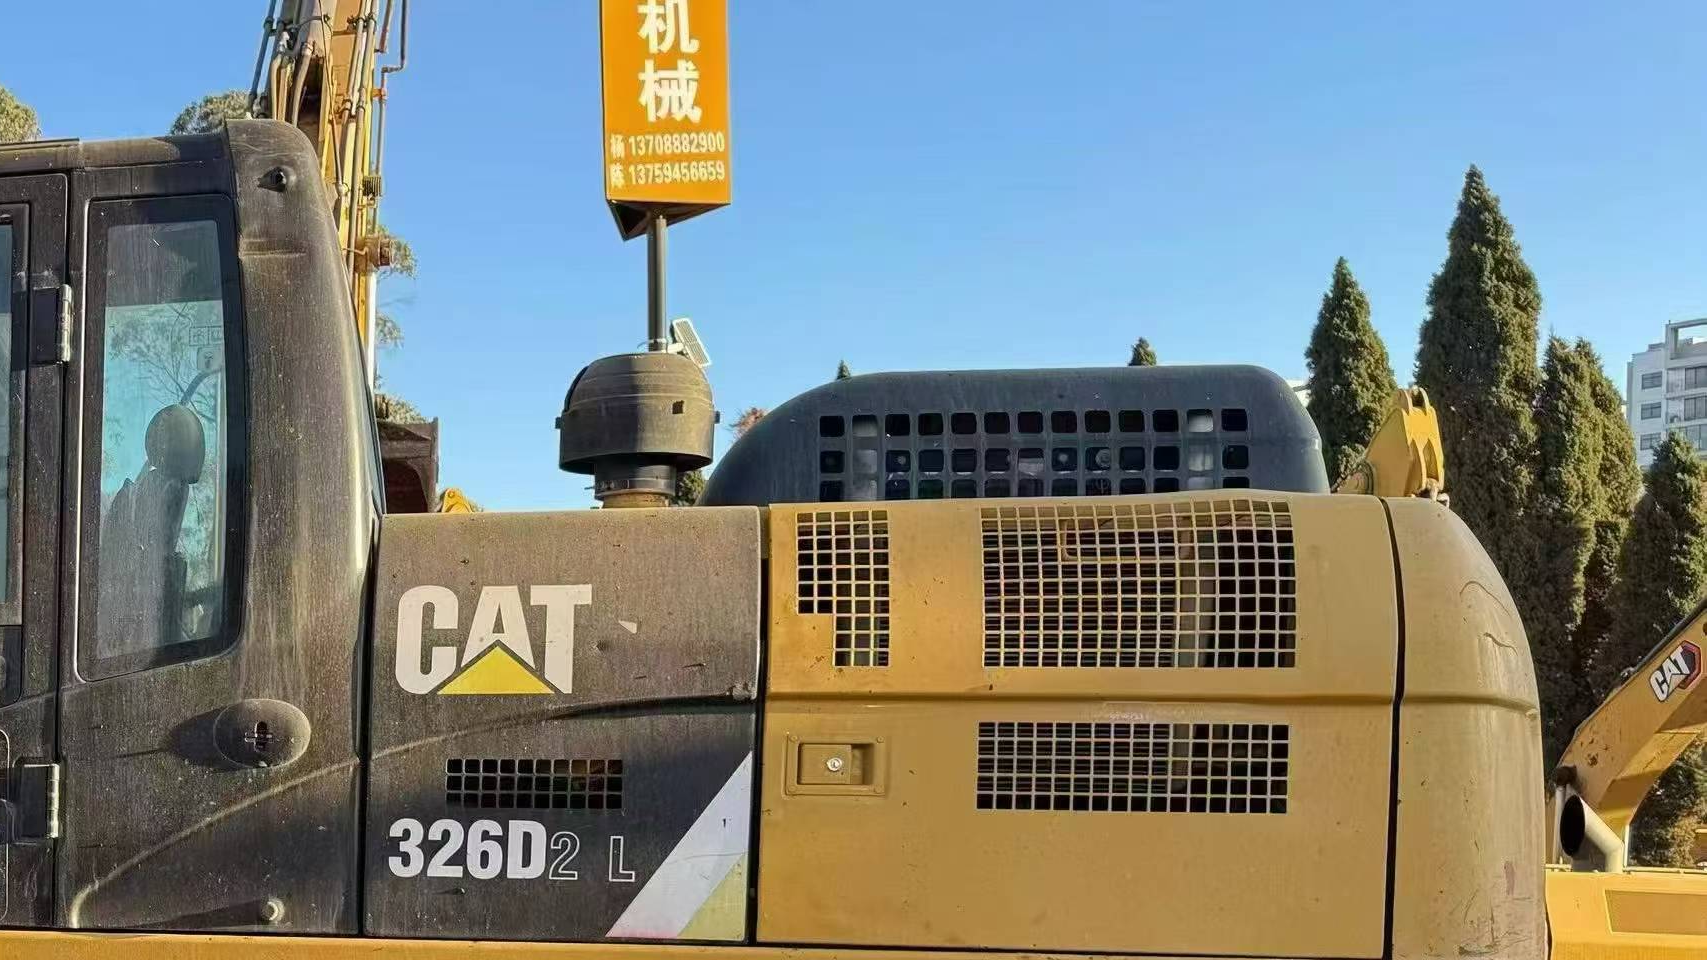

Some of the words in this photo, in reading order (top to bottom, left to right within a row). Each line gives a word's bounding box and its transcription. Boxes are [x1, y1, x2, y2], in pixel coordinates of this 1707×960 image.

[637, 0, 702, 124] 机械
[628, 131, 725, 157] 13708882900
[395, 584, 593, 696] CAT
[1650, 645, 1691, 701] CAT
[608, 836, 636, 884] L
